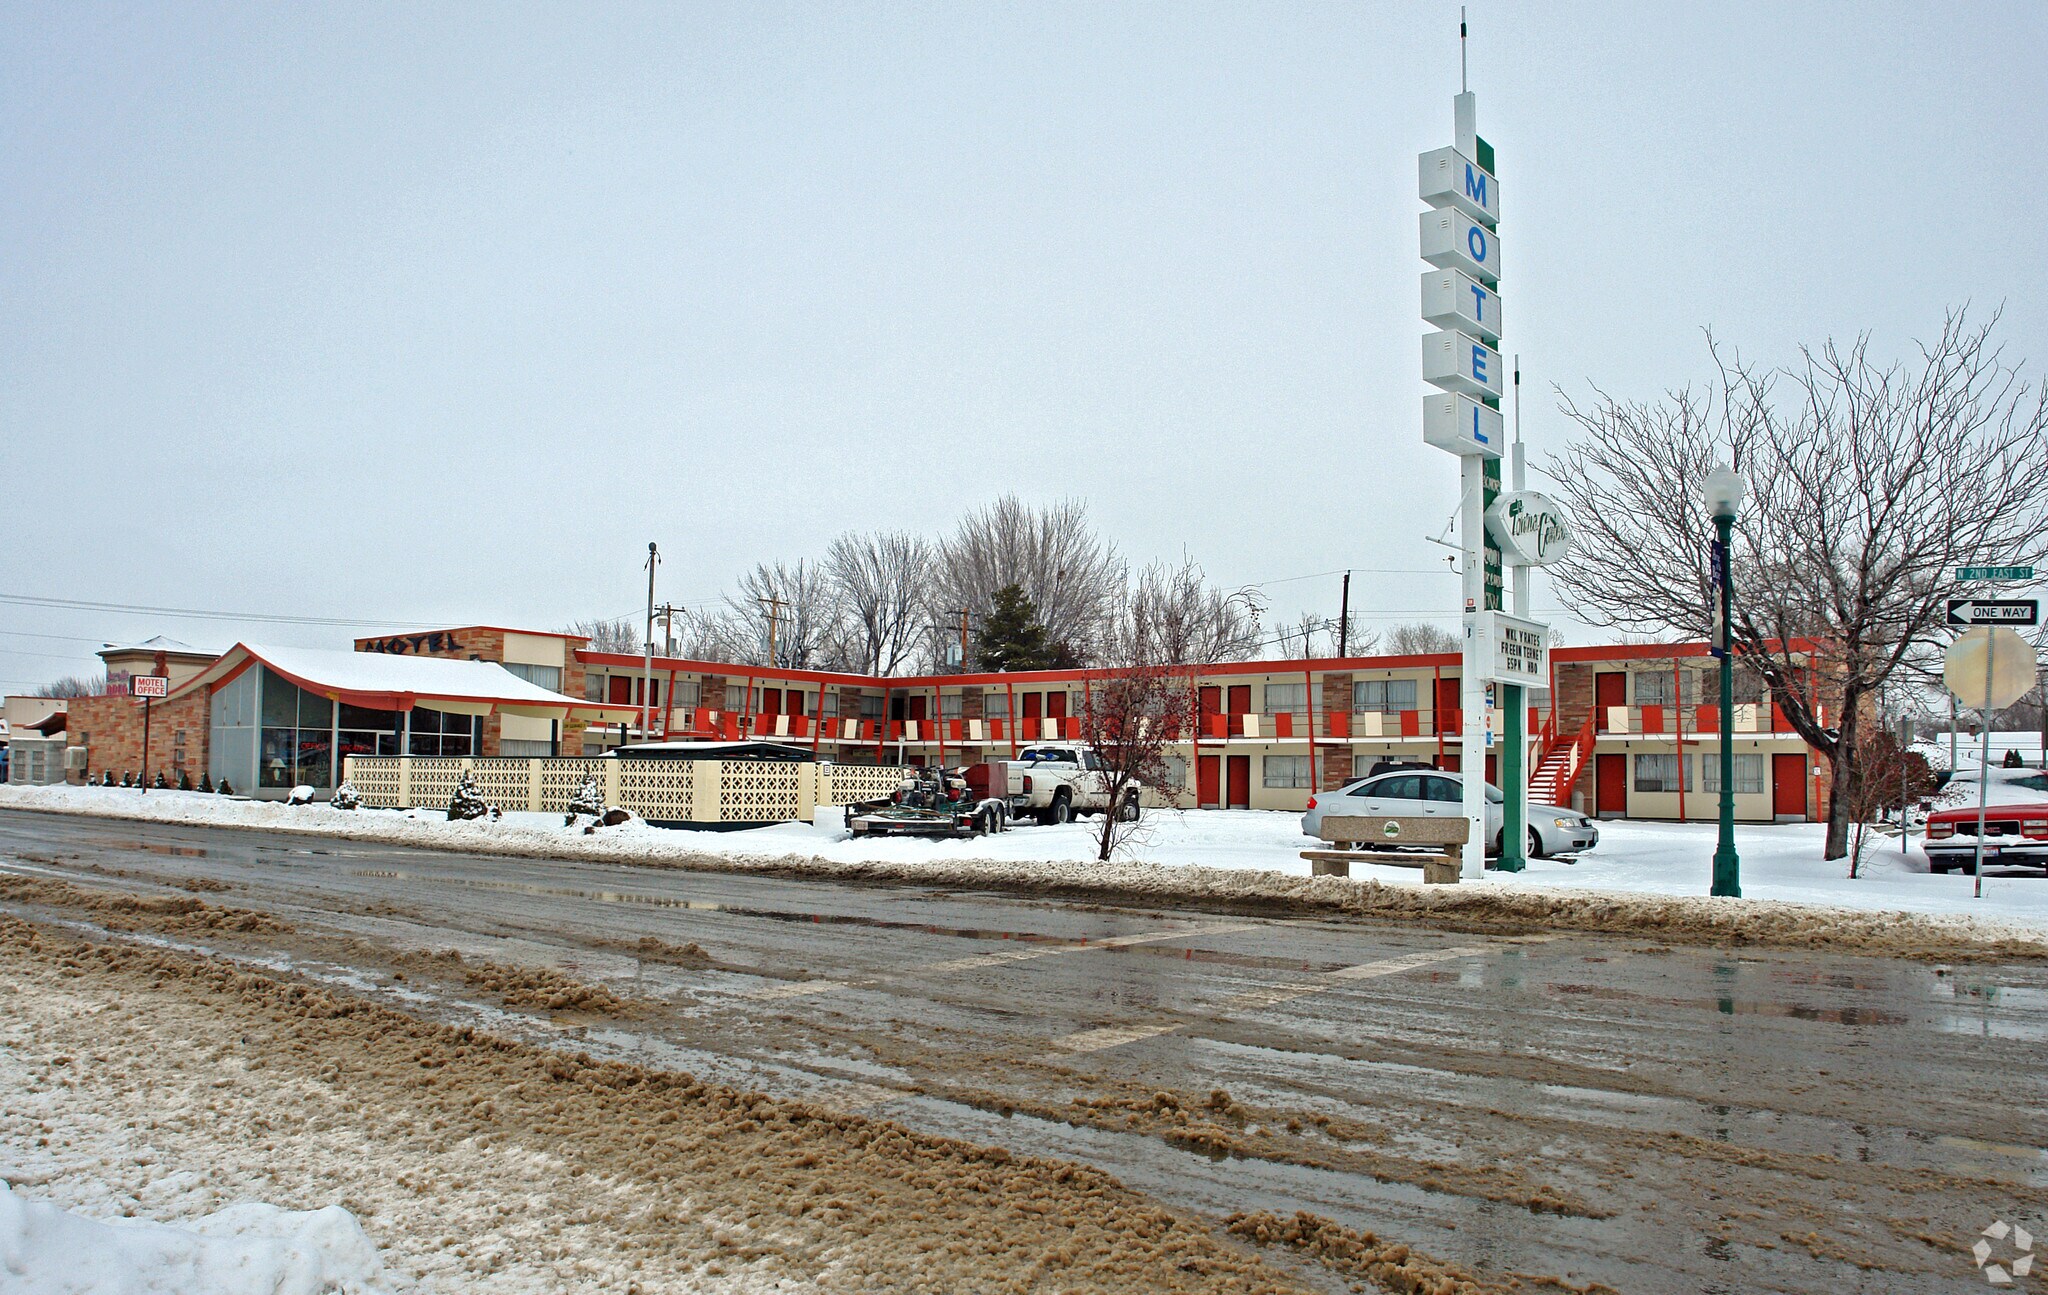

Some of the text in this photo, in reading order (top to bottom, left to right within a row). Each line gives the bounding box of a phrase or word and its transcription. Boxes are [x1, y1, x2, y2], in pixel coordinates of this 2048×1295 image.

[1465, 163, 1488, 444] MOTEL
[1957, 568, 2029, 579] N 2ND EAST ST
[1973, 608, 2028, 617] ONE WAY
[365, 632, 465, 655] MOTEL
[1507, 657, 1538, 674] ESPN HBO
[138, 678, 165, 687] MOTEL
[138, 687, 165, 695] OFFICE
